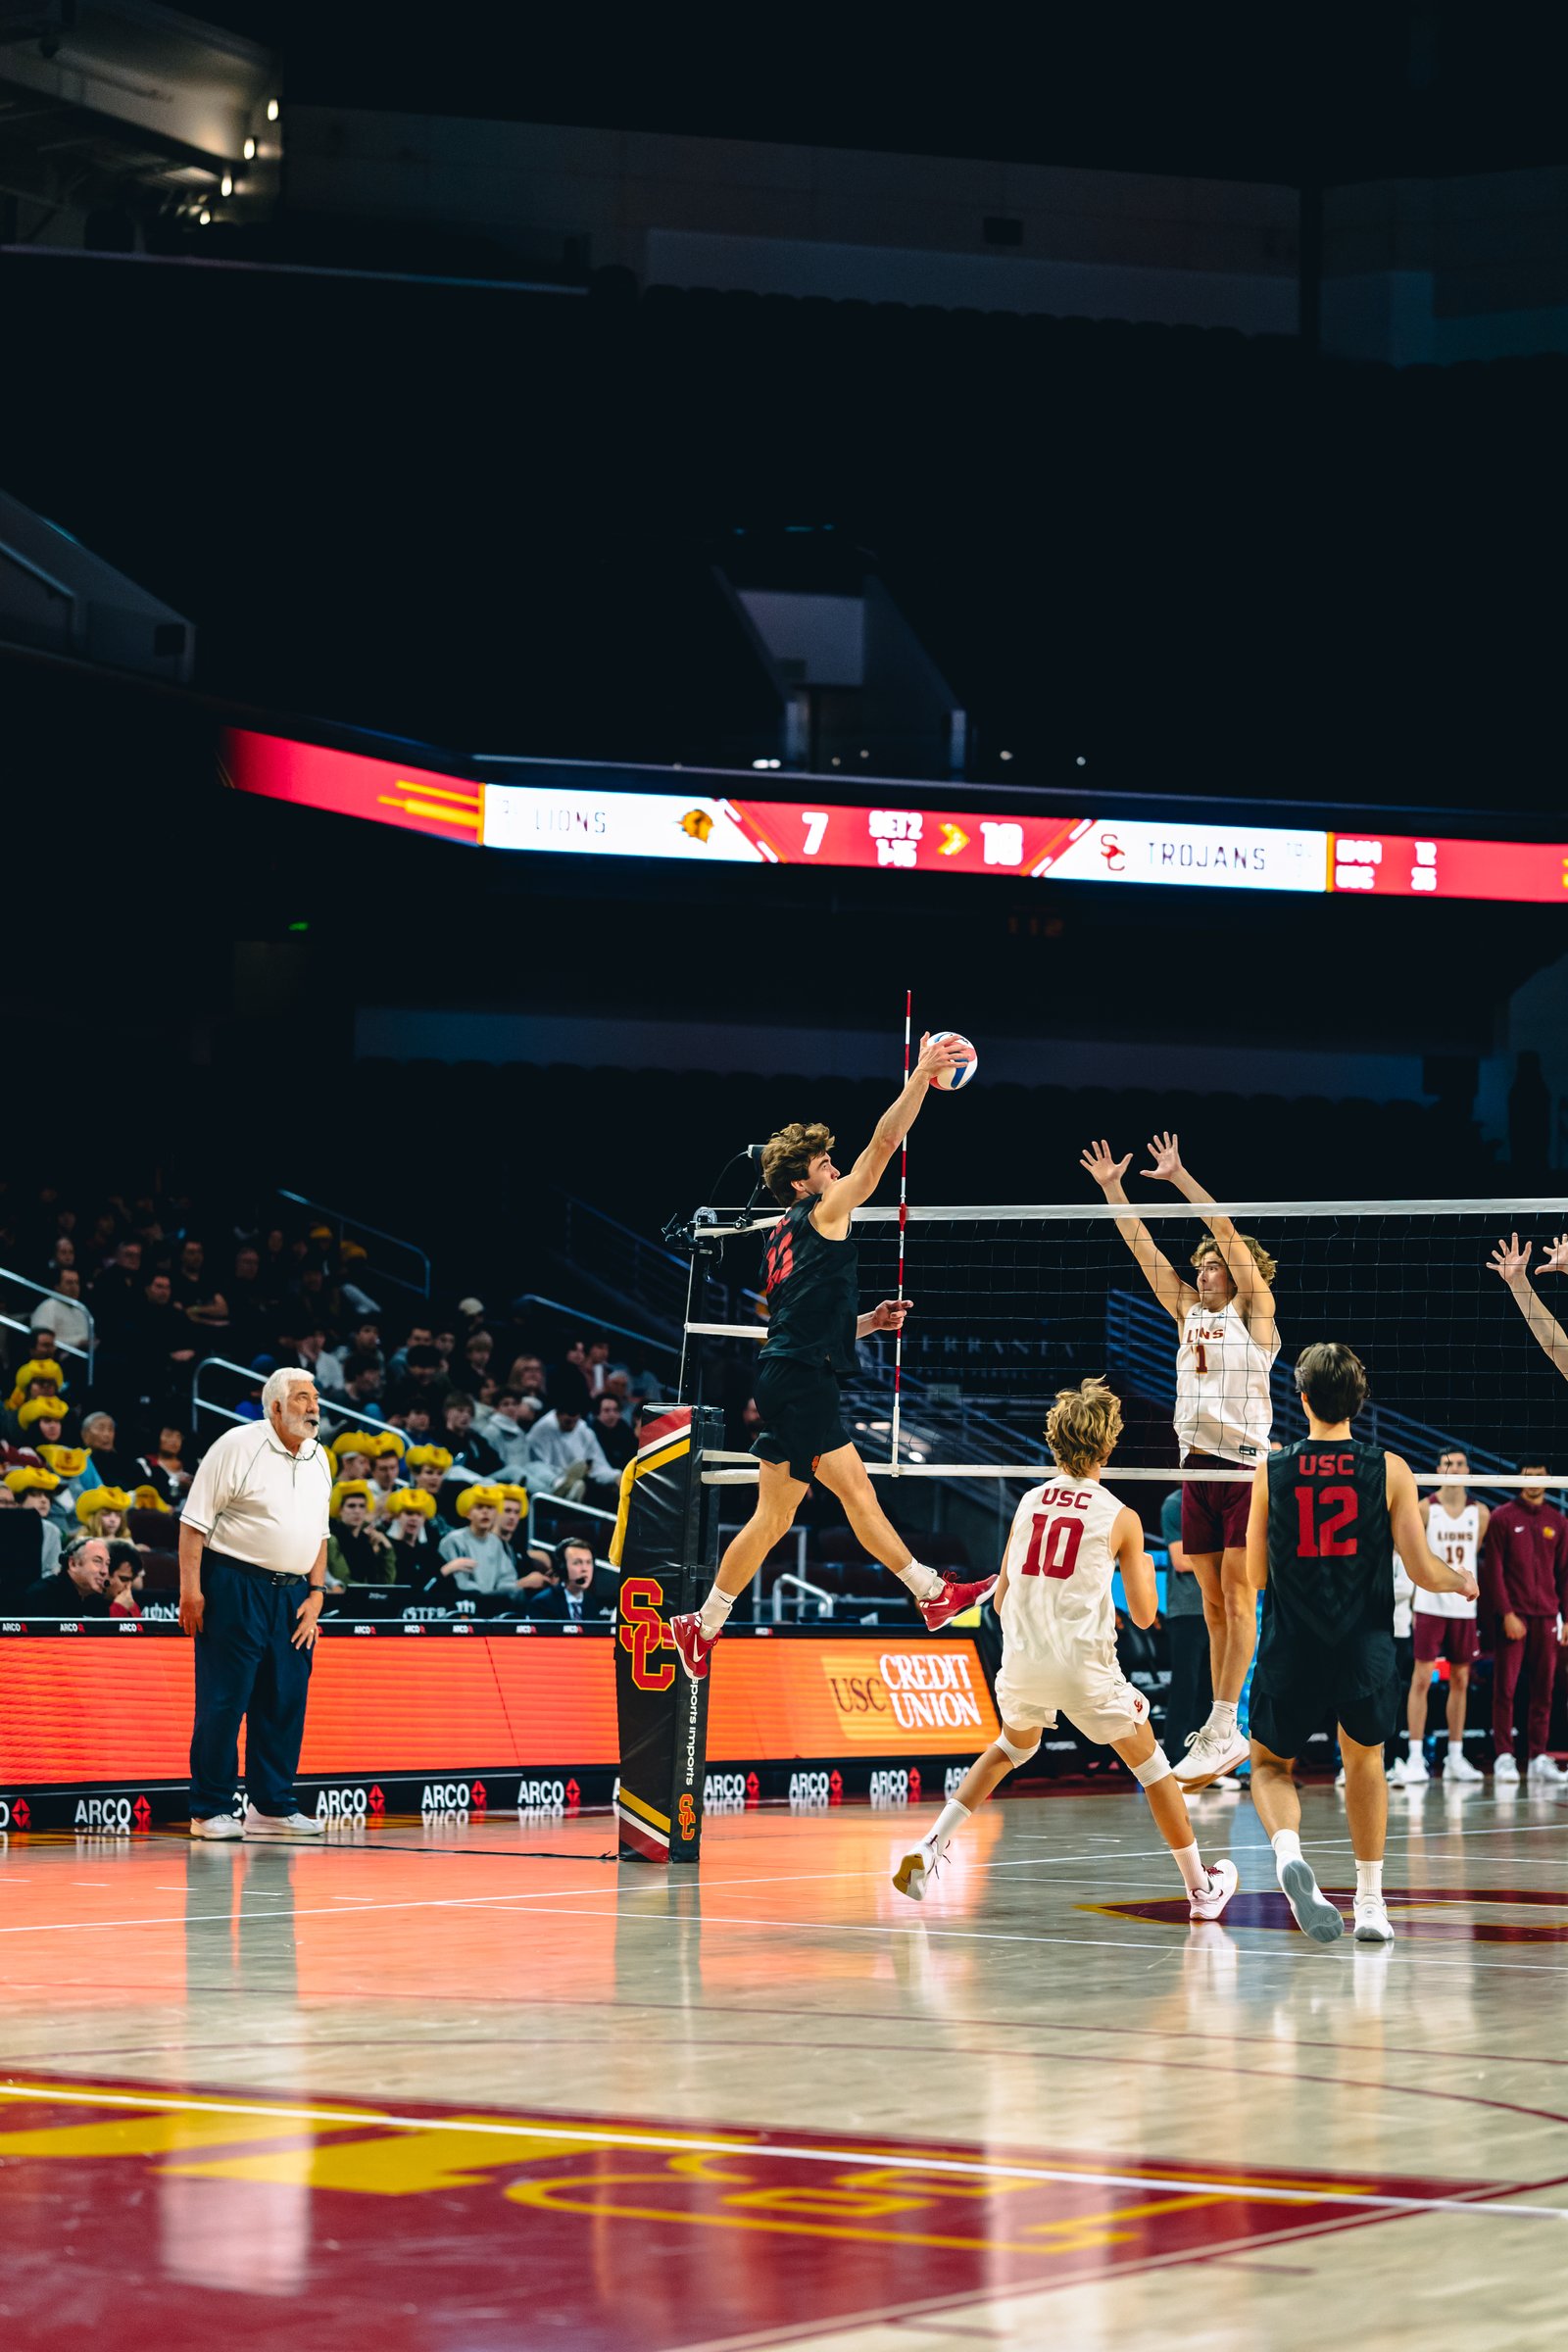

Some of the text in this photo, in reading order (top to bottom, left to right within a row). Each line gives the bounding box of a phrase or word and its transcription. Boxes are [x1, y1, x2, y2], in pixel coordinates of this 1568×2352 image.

[535, 808, 606, 833] LIONS
[801, 811, 829, 856] 7
[1149, 841, 1265, 870] TROJANS
[1298, 1453, 1355, 1477] USC
[1041, 1487, 1093, 1511] USC
[1295, 1486, 1359, 1557] 12
[1020, 1512, 1085, 1581] 10
[1437, 1531, 1474, 1542] LIONS
[1446, 1545, 1465, 1564] 19
[2, 1622, 22, 1633] ARCO
[59, 1623, 78, 1633] ARCO
[119, 1623, 137, 1633] ARCO
[618, 1576, 677, 1691] SC
[879, 1653, 973, 1690] CREDIT
[830, 1677, 887, 1713] USC
[889, 1690, 983, 1729] UNION
[703, 1773, 746, 1798] ARCO
[788, 1772, 829, 1796] ARCO
[869, 1769, 909, 1793] ARCO
[944, 1767, 972, 1789] ARC
[316, 1788, 368, 1814] ARCO
[420, 1783, 470, 1810] ARCO
[516, 1780, 565, 1805] ARCO
[74, 1797, 132, 1825] ARCO
[677, 1792, 698, 1841] SC
